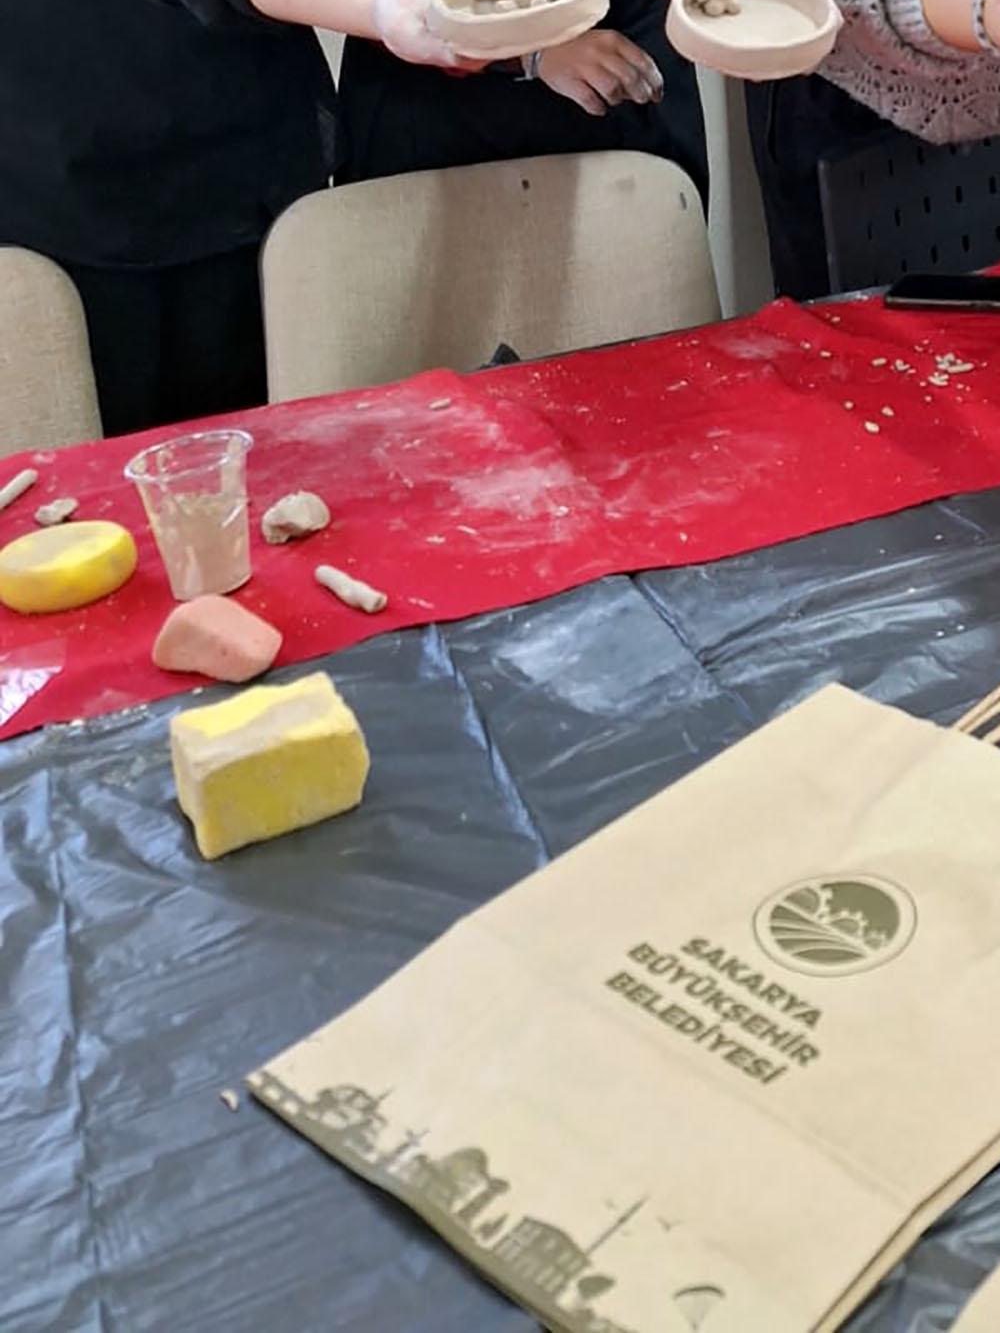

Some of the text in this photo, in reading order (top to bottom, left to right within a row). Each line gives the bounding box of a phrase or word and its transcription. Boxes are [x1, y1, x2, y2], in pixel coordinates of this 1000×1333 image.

[605, 972, 788, 1084] BELEDİYESİ
[628, 943, 819, 1066] BÜYÜKŞEHİR
[681, 938, 821, 1028] SAKARYA
